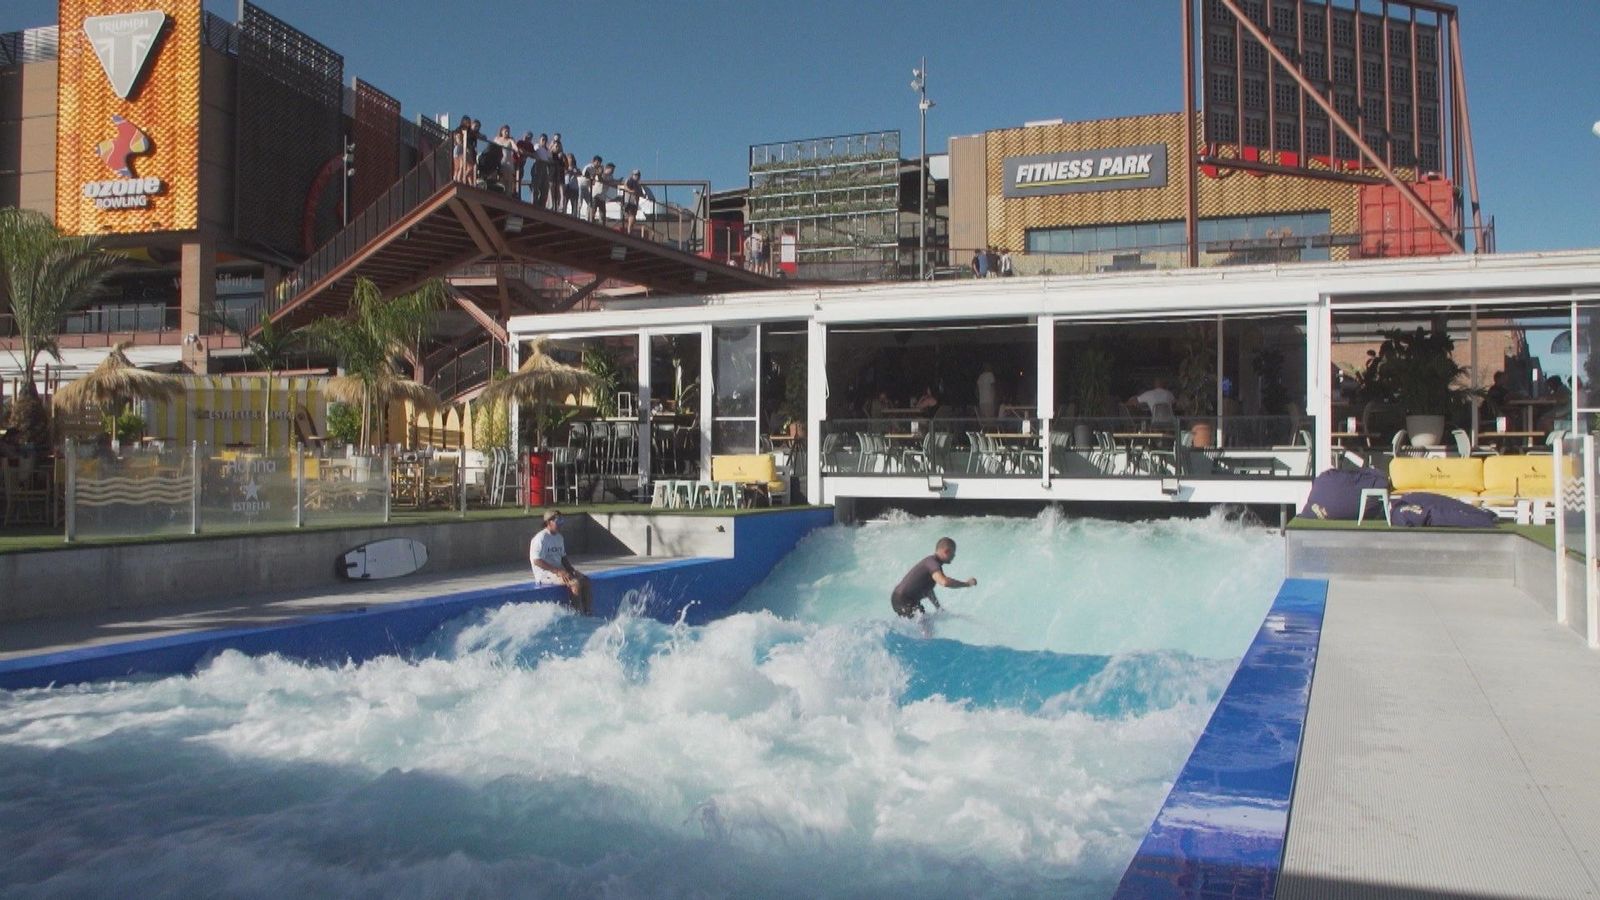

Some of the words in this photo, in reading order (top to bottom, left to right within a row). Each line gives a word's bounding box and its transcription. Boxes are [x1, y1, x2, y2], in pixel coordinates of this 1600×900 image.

[99, 18, 149, 32] TRIUMPH
[1016, 158, 1094, 183] FITNESS
[1098, 153, 1153, 176] PARK
[84, 176, 160, 198] ozone
[96, 195, 147, 208] BOWLING
